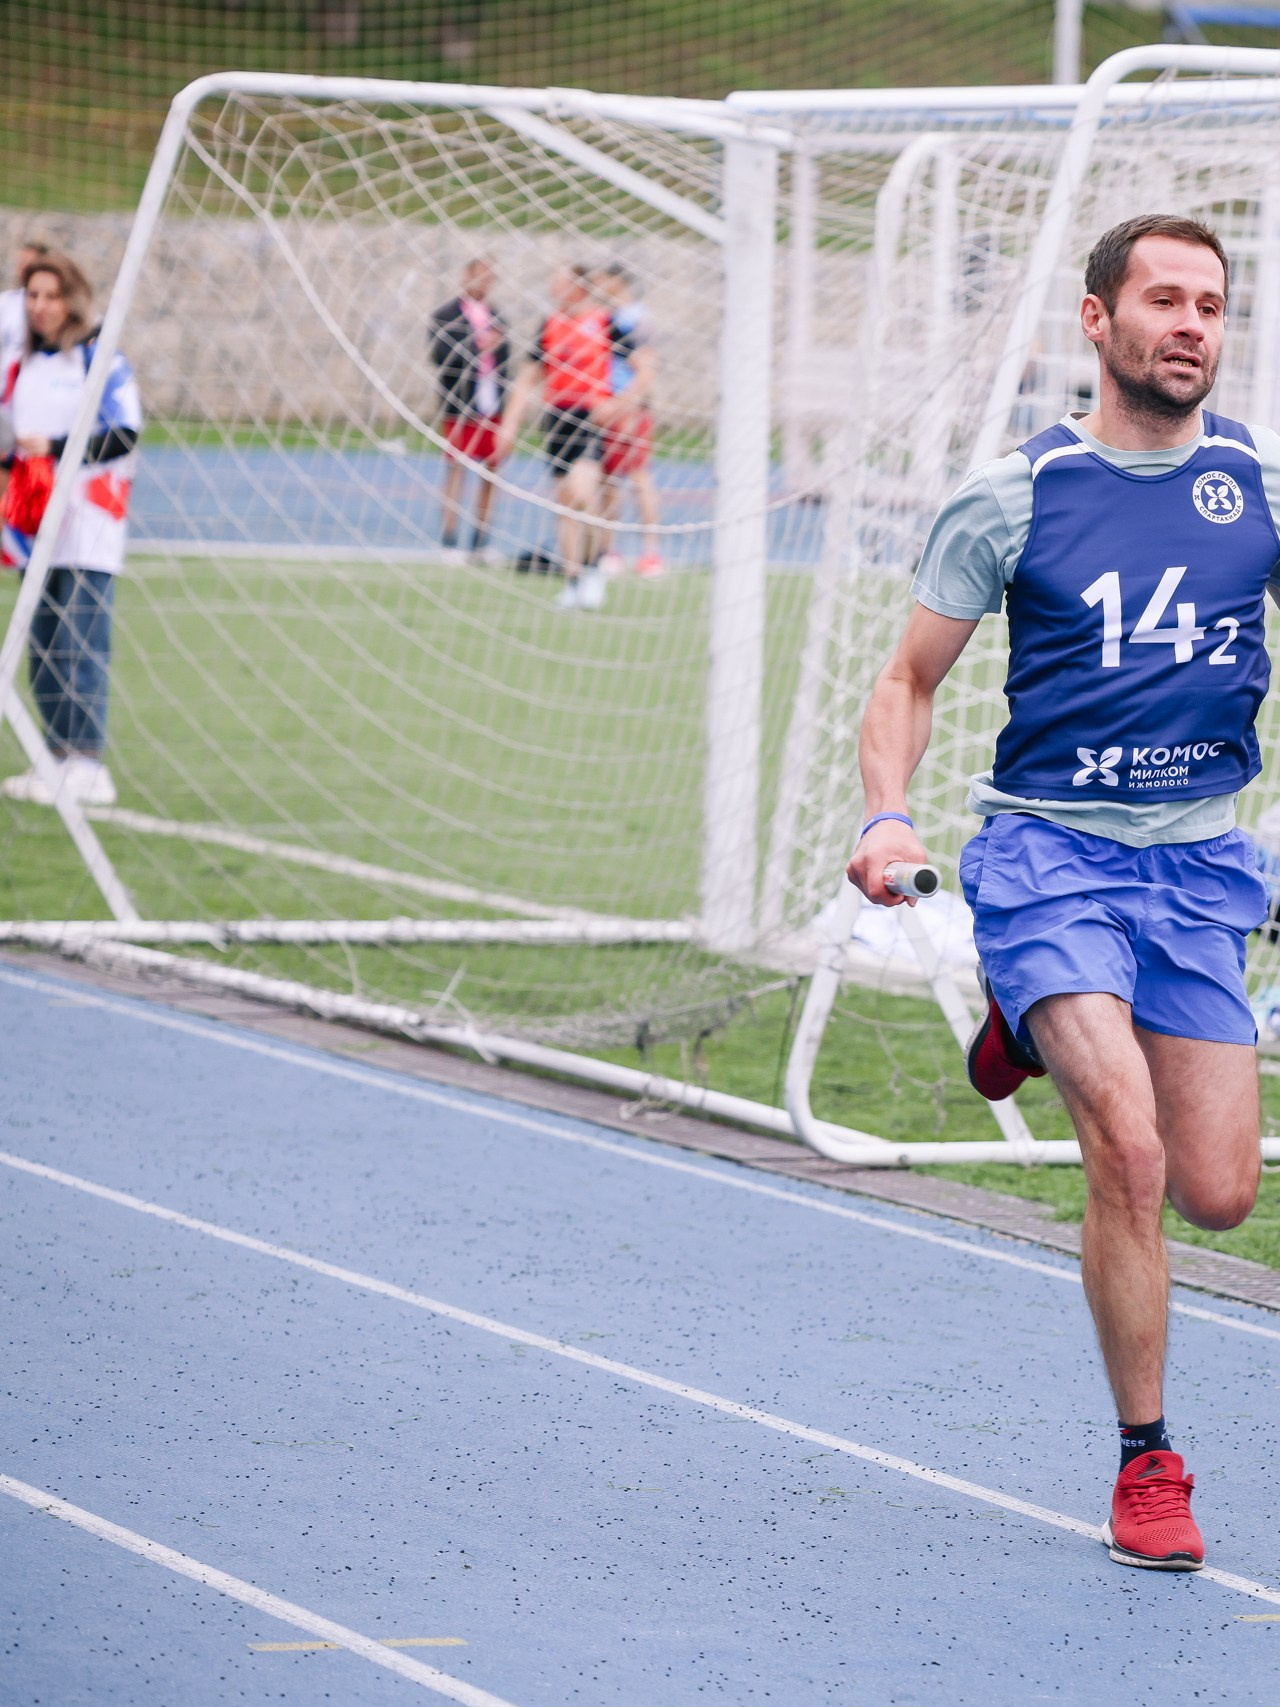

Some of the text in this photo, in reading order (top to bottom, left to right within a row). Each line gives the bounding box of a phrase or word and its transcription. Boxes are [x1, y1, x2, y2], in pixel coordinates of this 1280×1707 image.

[1195, 472, 1238, 490] КОМОС ГРУПП
[1199, 505, 1242, 522] СПАРТАКИАДА
[1079, 566, 1240, 668] 14 2
[1131, 741, 1226, 767] КОМОС
[1129, 765, 1189, 780] МИЛКОМ
[1128, 778, 1189, 788] ИЖМОЛОКО
